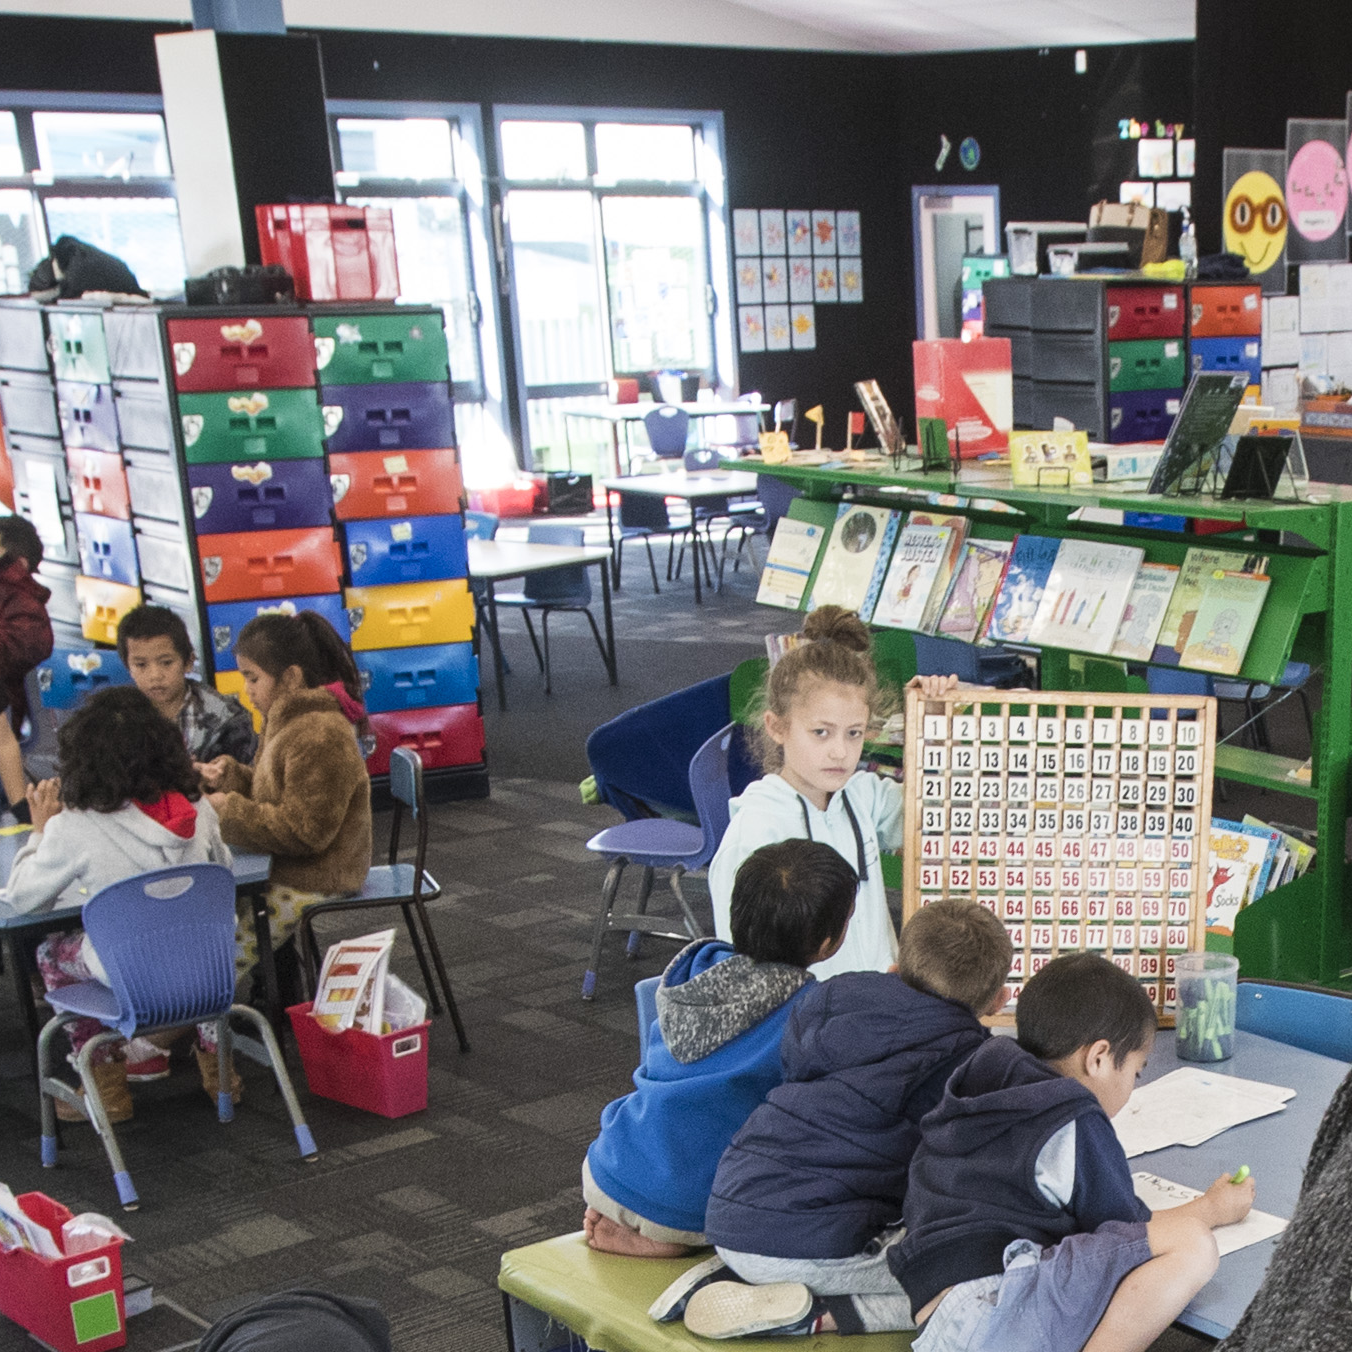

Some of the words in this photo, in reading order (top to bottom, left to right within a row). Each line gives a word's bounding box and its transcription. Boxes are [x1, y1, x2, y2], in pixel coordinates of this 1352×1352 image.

[960, 720, 969, 738] 2
[988, 721, 997, 739] 3
[1016, 721, 1025, 737] 4
[1045, 723, 1054, 740] 5
[1074, 723, 1083, 741] 6
[1101, 723, 1109, 740] 7
[1129, 724, 1138, 741] 8
[1156, 725, 1165, 742] 9
[1181, 726, 1197, 743] 10
[928, 751, 942, 767] 11
[956, 751, 971, 768] 12
[984, 751, 999, 769] 13
[1013, 753, 1028, 769] 14
[1042, 753, 1057, 770] 15
[1069, 753, 1085, 770] 16
[1097, 754, 1112, 771] 17
[1125, 755, 1139, 772] 18
[1152, 755, 1167, 772] 19
[1177, 755, 1195, 771] 20
[925, 780, 942, 797] 21
[953, 781, 972, 798] 22
[982, 781, 1000, 798] 23
[1010, 781, 1029, 798] 24
[1040, 782, 1058, 799] 25
[1067, 783, 1085, 800] 26
[1095, 784, 1112, 800] 27
[1121, 785, 1139, 801] 28
[1149, 785, 1167, 802] 29
[1177, 786, 1195, 803] 30
[926, 811, 942, 828] 31
[954, 811, 972, 828] 32
[981, 812, 1000, 829] 33
[1009, 812, 1027, 829] 34
[1038, 813, 1056, 830] 35
[1066, 813, 1084, 830] 36
[1093, 814, 1110, 831] 37
[1120, 815, 1138, 831] 38
[1148, 815, 1166, 832] 39
[1175, 816, 1193, 833] 40
[923, 840, 939, 856] 41
[951, 840, 970, 856] 42
[979, 840, 997, 857] 43
[1006, 841, 1025, 857] 44
[1035, 841, 1053, 858] 45
[1062, 842, 1081, 858] 46
[1089, 842, 1107, 858] 47
[1116, 841, 1135, 858] 48
[1171, 842, 1189, 859] 50
[922, 869, 939, 886] 51
[951, 869, 970, 886] 52
[979, 870, 997, 887] 53
[1006, 870, 1024, 887] 54
[1034, 871, 1052, 887] 55
[1062, 871, 1080, 887] 56
[1089, 871, 1107, 887] 57
[1116, 871, 1134, 888] 58
[1143, 871, 1161, 888] 59
[1171, 872, 1189, 888] 60
[1006, 900, 1024, 916] 64
[1034, 900, 1052, 916] 65
[1061, 900, 1079, 916] 66
[1088, 900, 1105, 917] 67
[1115, 900, 1133, 916] 68
[1141, 900, 1160, 917] 69
[1169, 901, 1187, 917] 70
[1033, 928, 1051, 945] 75
[1061, 928, 1078, 945] 76
[1087, 928, 1105, 945] 77
[1114, 928, 1132, 945] 78
[1141, 929, 1159, 946] 79
[1168, 929, 1186, 945] 80
[1140, 958, 1158, 974] 89
